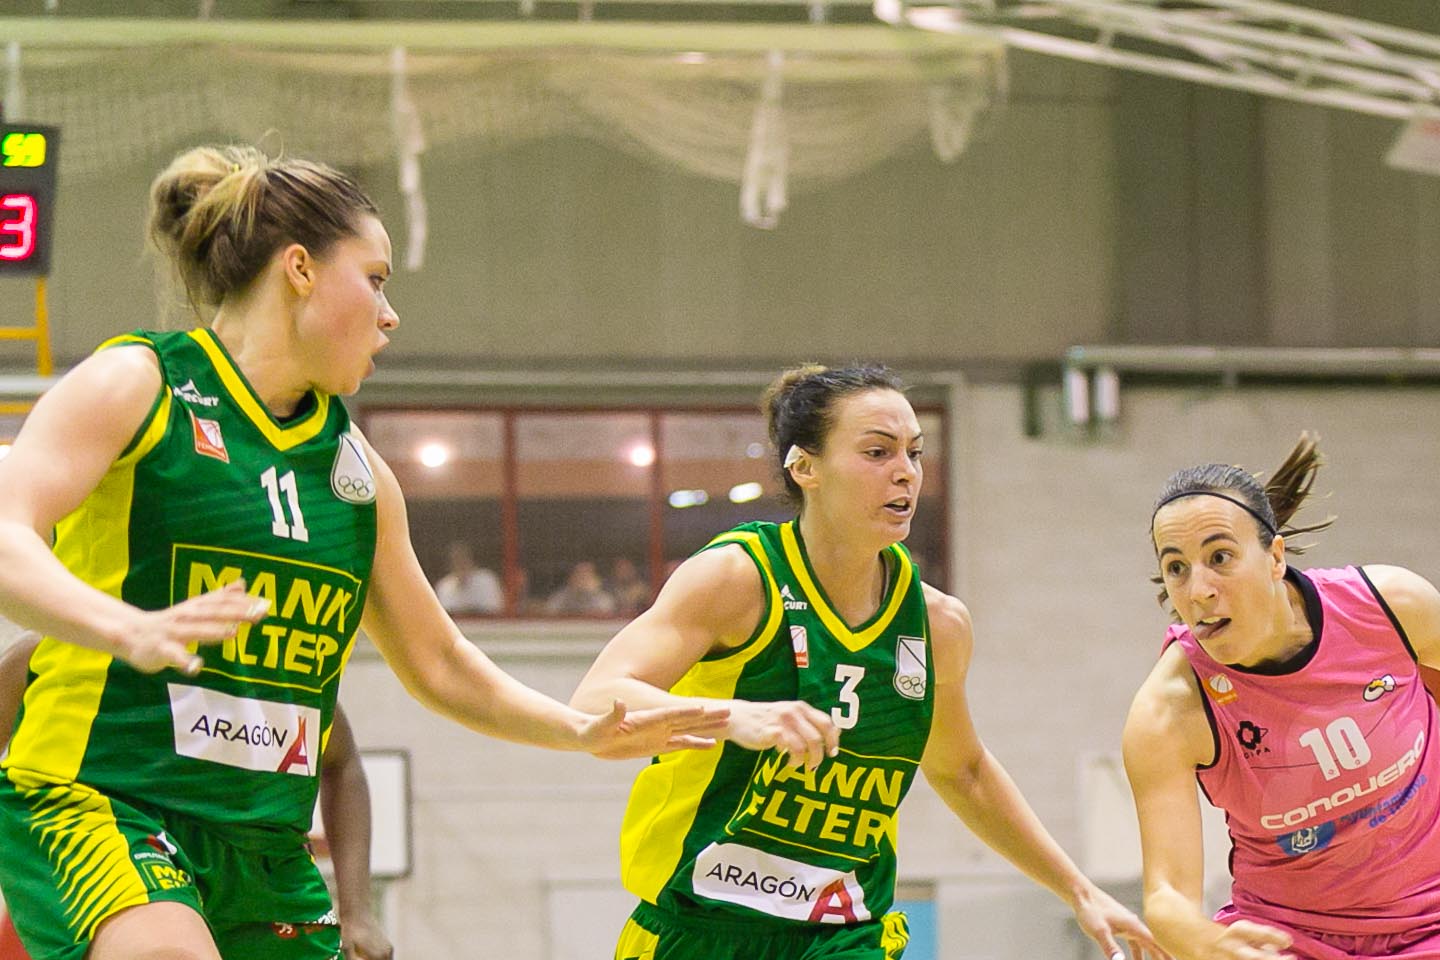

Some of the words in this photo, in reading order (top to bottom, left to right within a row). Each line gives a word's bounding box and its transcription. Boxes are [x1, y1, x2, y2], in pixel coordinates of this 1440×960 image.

[260, 466, 309, 543] 11
[184, 622, 339, 677] ILTER
[831, 664, 865, 730] 3
[191, 715, 288, 748] ARAGÓN
[1299, 716, 1372, 782] 10
[706, 863, 816, 903] ARAGÓN
